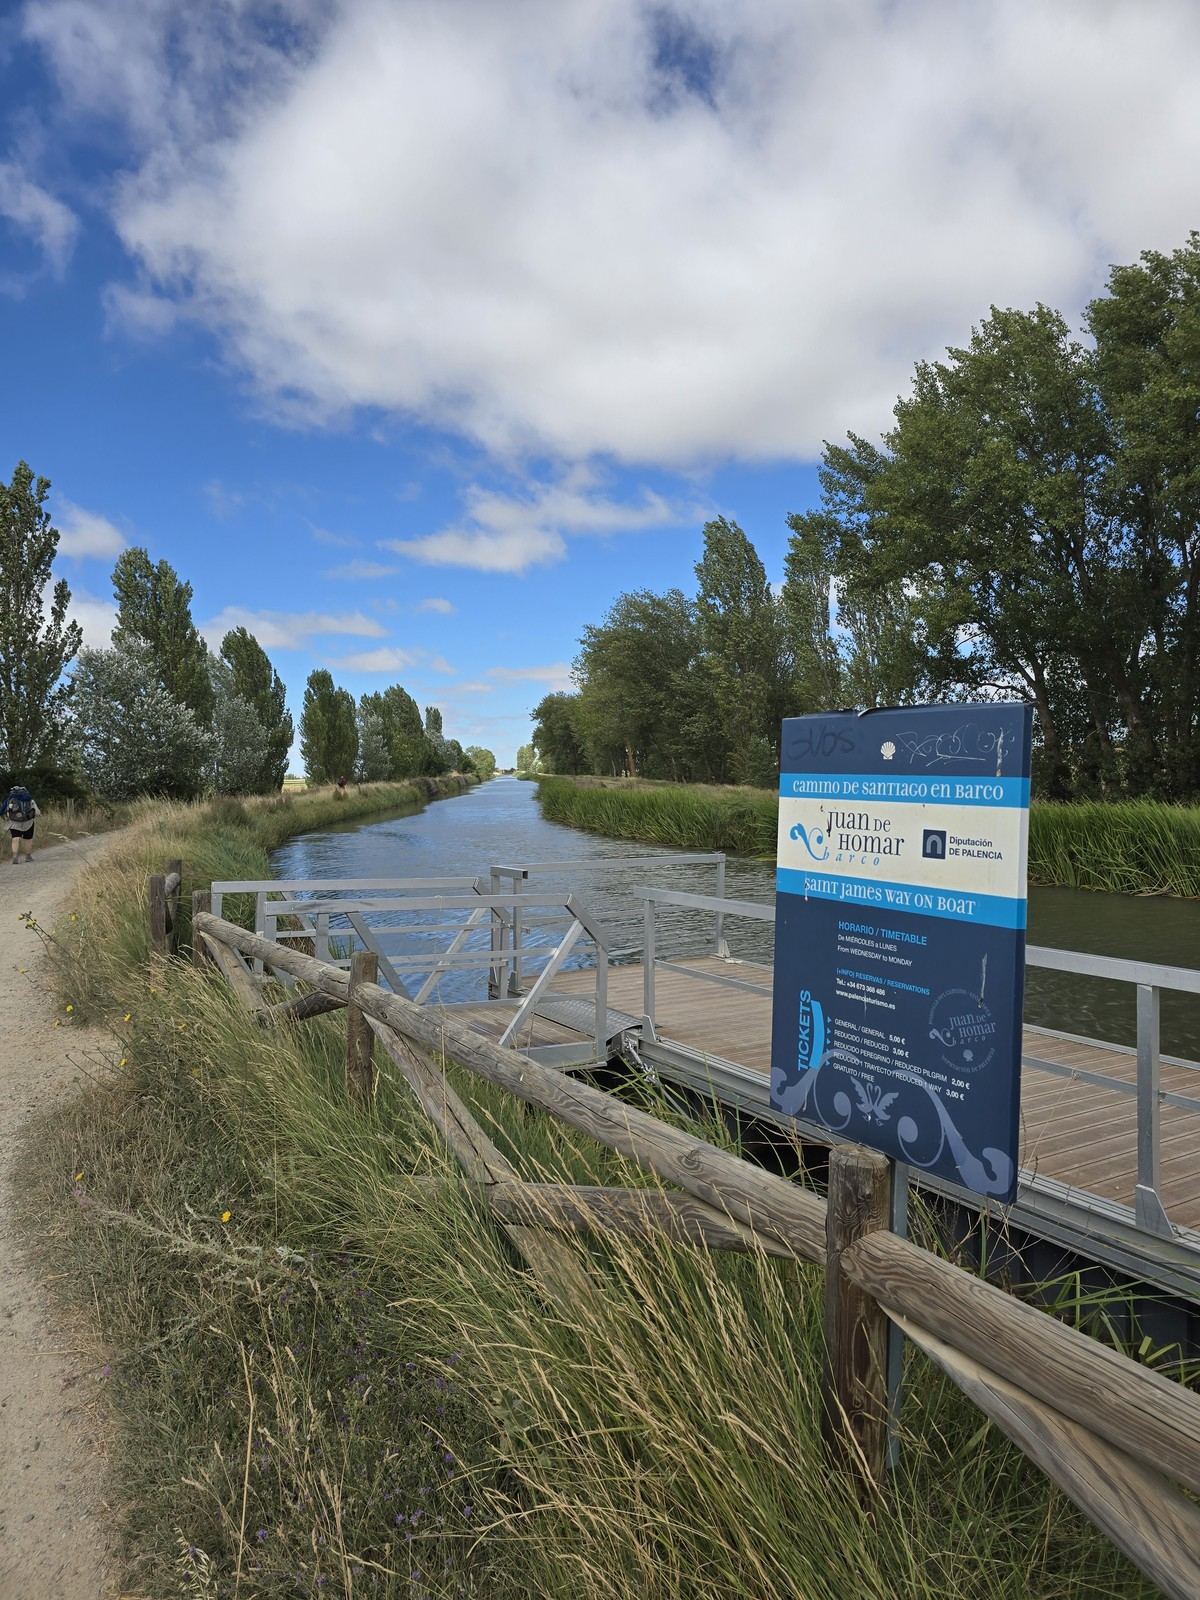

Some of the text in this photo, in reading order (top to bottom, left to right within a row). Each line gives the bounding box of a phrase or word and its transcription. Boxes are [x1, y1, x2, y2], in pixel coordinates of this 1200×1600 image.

[949, 836, 993, 847] Diputación
[949, 848, 1003, 860] DE PALENCIA
[914, 893, 935, 910] ON
[838, 920, 874, 935] HORARIO
[880, 928, 928, 946] TIMETABLE
[837, 945, 850, 953] From
[850, 947, 881, 960] WEDNESDAY
[888, 956, 913, 967] MONDAY
[879, 943, 897, 952] LUNES
[855, 971, 883, 985] RESERVAS
[886, 979, 931, 996] RESERVATIONS
[797, 989, 811, 1072] TICKETS
[834, 1018, 858, 1031] GENERAL
[861, 1026, 886, 1040] GENERAL
[901, 1037, 906, 1045] €
[834, 1029, 860, 1043] REDUCIDO
[863, 1038, 890, 1052] REDUCED
[892, 1047, 905, 1057] 3,00
[832, 1062, 858, 1077] GRATUITO
[860, 1072, 875, 1083] FREE
[833, 1040, 860, 1054] REDUCIDO
[860, 1048, 891, 1065] PEREGRINO
[894, 1059, 922, 1074] REDUCED
[922, 1068, 948, 1083] PILGRIM
[951, 1078, 965, 1088] 2,00
[965, 1082, 971, 1090] €
[833, 1051, 860, 1066] REDUCIDO
[863, 1061, 892, 1076] TRAYECTO
[895, 1071, 923, 1087] REDUCED
[928, 1082, 942, 1093] WAY
[945, 1088, 959, 1099] 3,00
[959, 1093, 965, 1101] €
